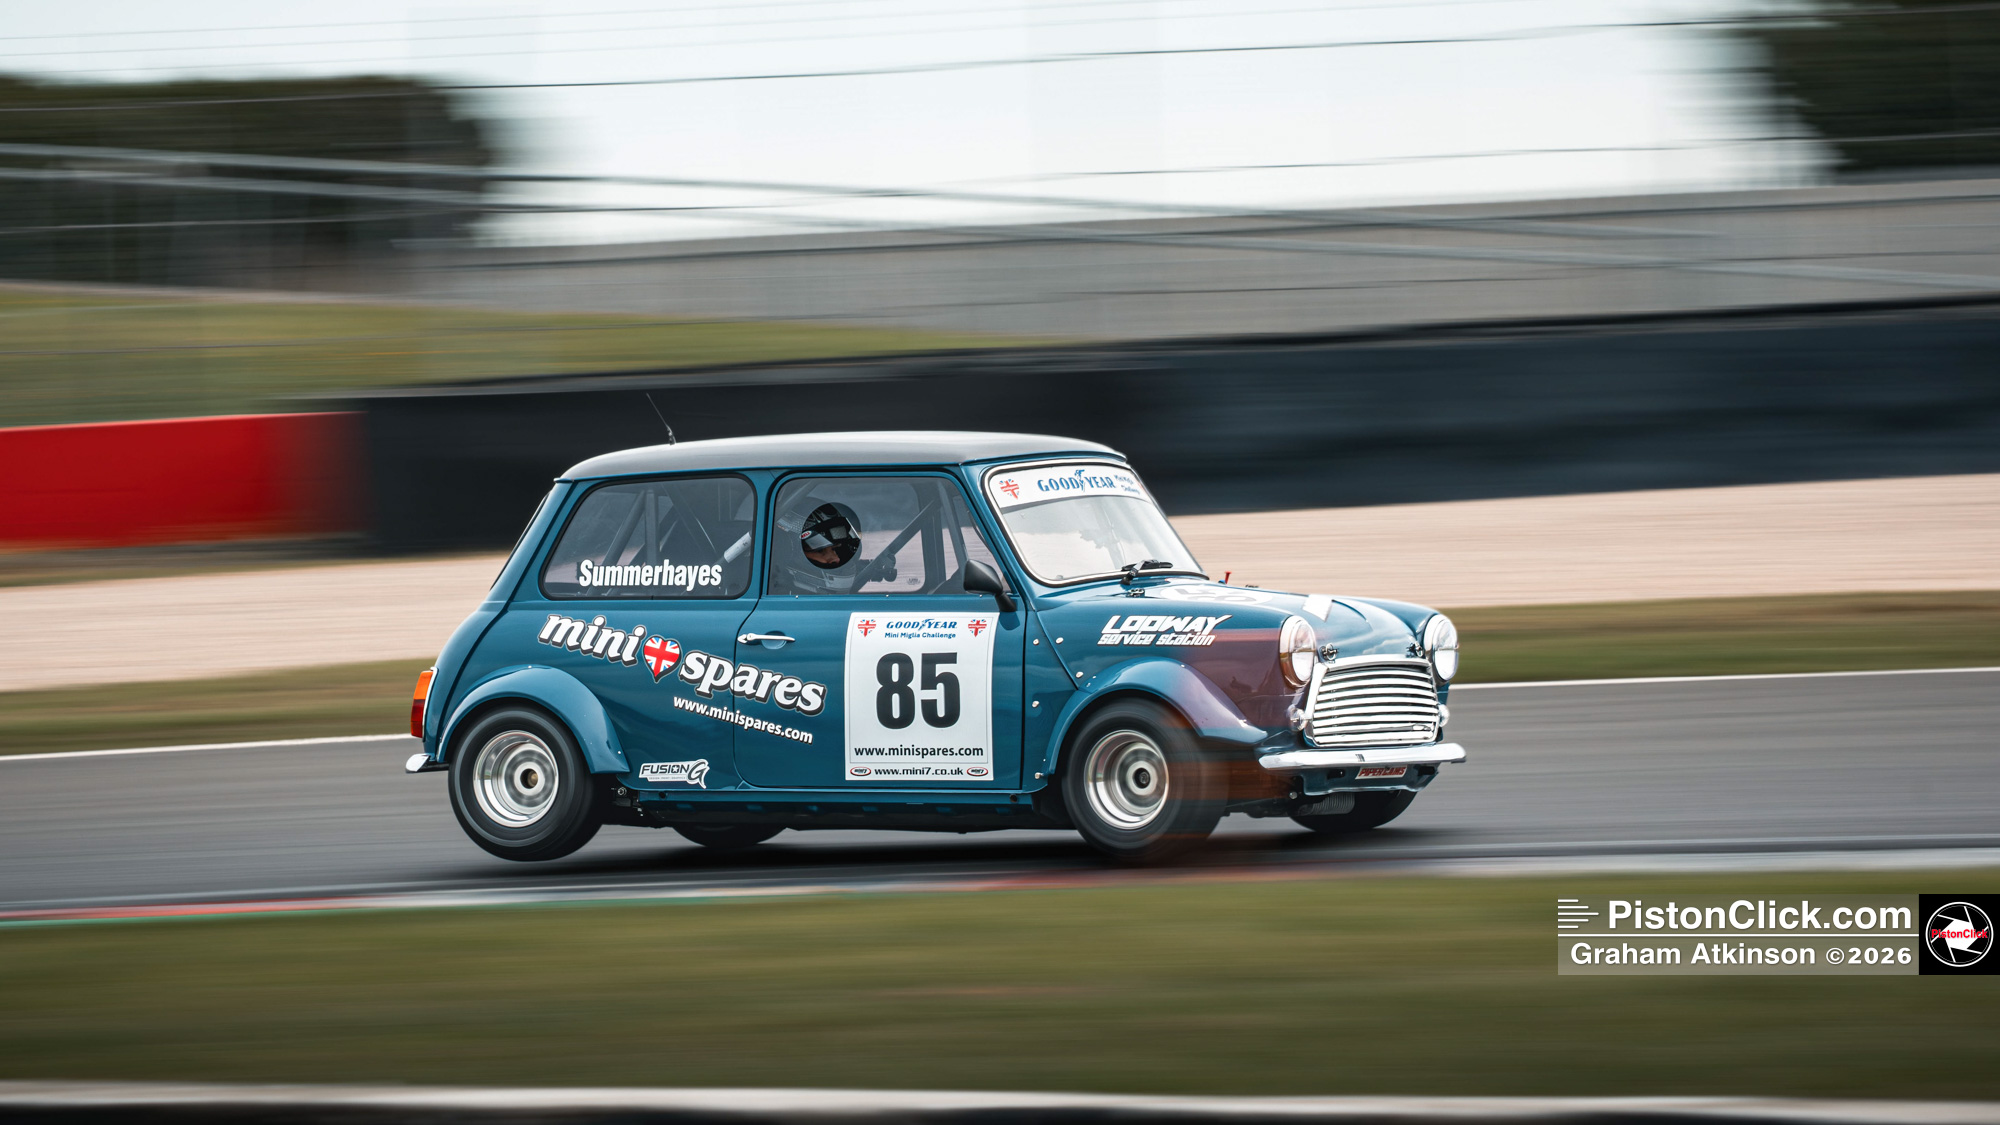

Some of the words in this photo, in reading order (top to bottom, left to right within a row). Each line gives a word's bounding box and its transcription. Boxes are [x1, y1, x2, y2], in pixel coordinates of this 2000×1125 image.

[1037, 470, 1117, 492] GOODYEAR
[579, 559, 723, 591] Summerhayes
[886, 619, 957, 630] GOODYEAR
[900, 632, 920, 640] Miglia
[922, 632, 956, 640] Challenge
[1097, 632, 1157, 646] service
[1155, 632, 1217, 646] station
[538, 614, 647, 665] mini
[679, 651, 827, 716] spares
[876, 652, 961, 730] 85
[673, 696, 814, 745] www.minispares.com
[854, 744, 984, 759] www.minispares.com
[874, 766, 964, 775] www.mini7.co.uk
